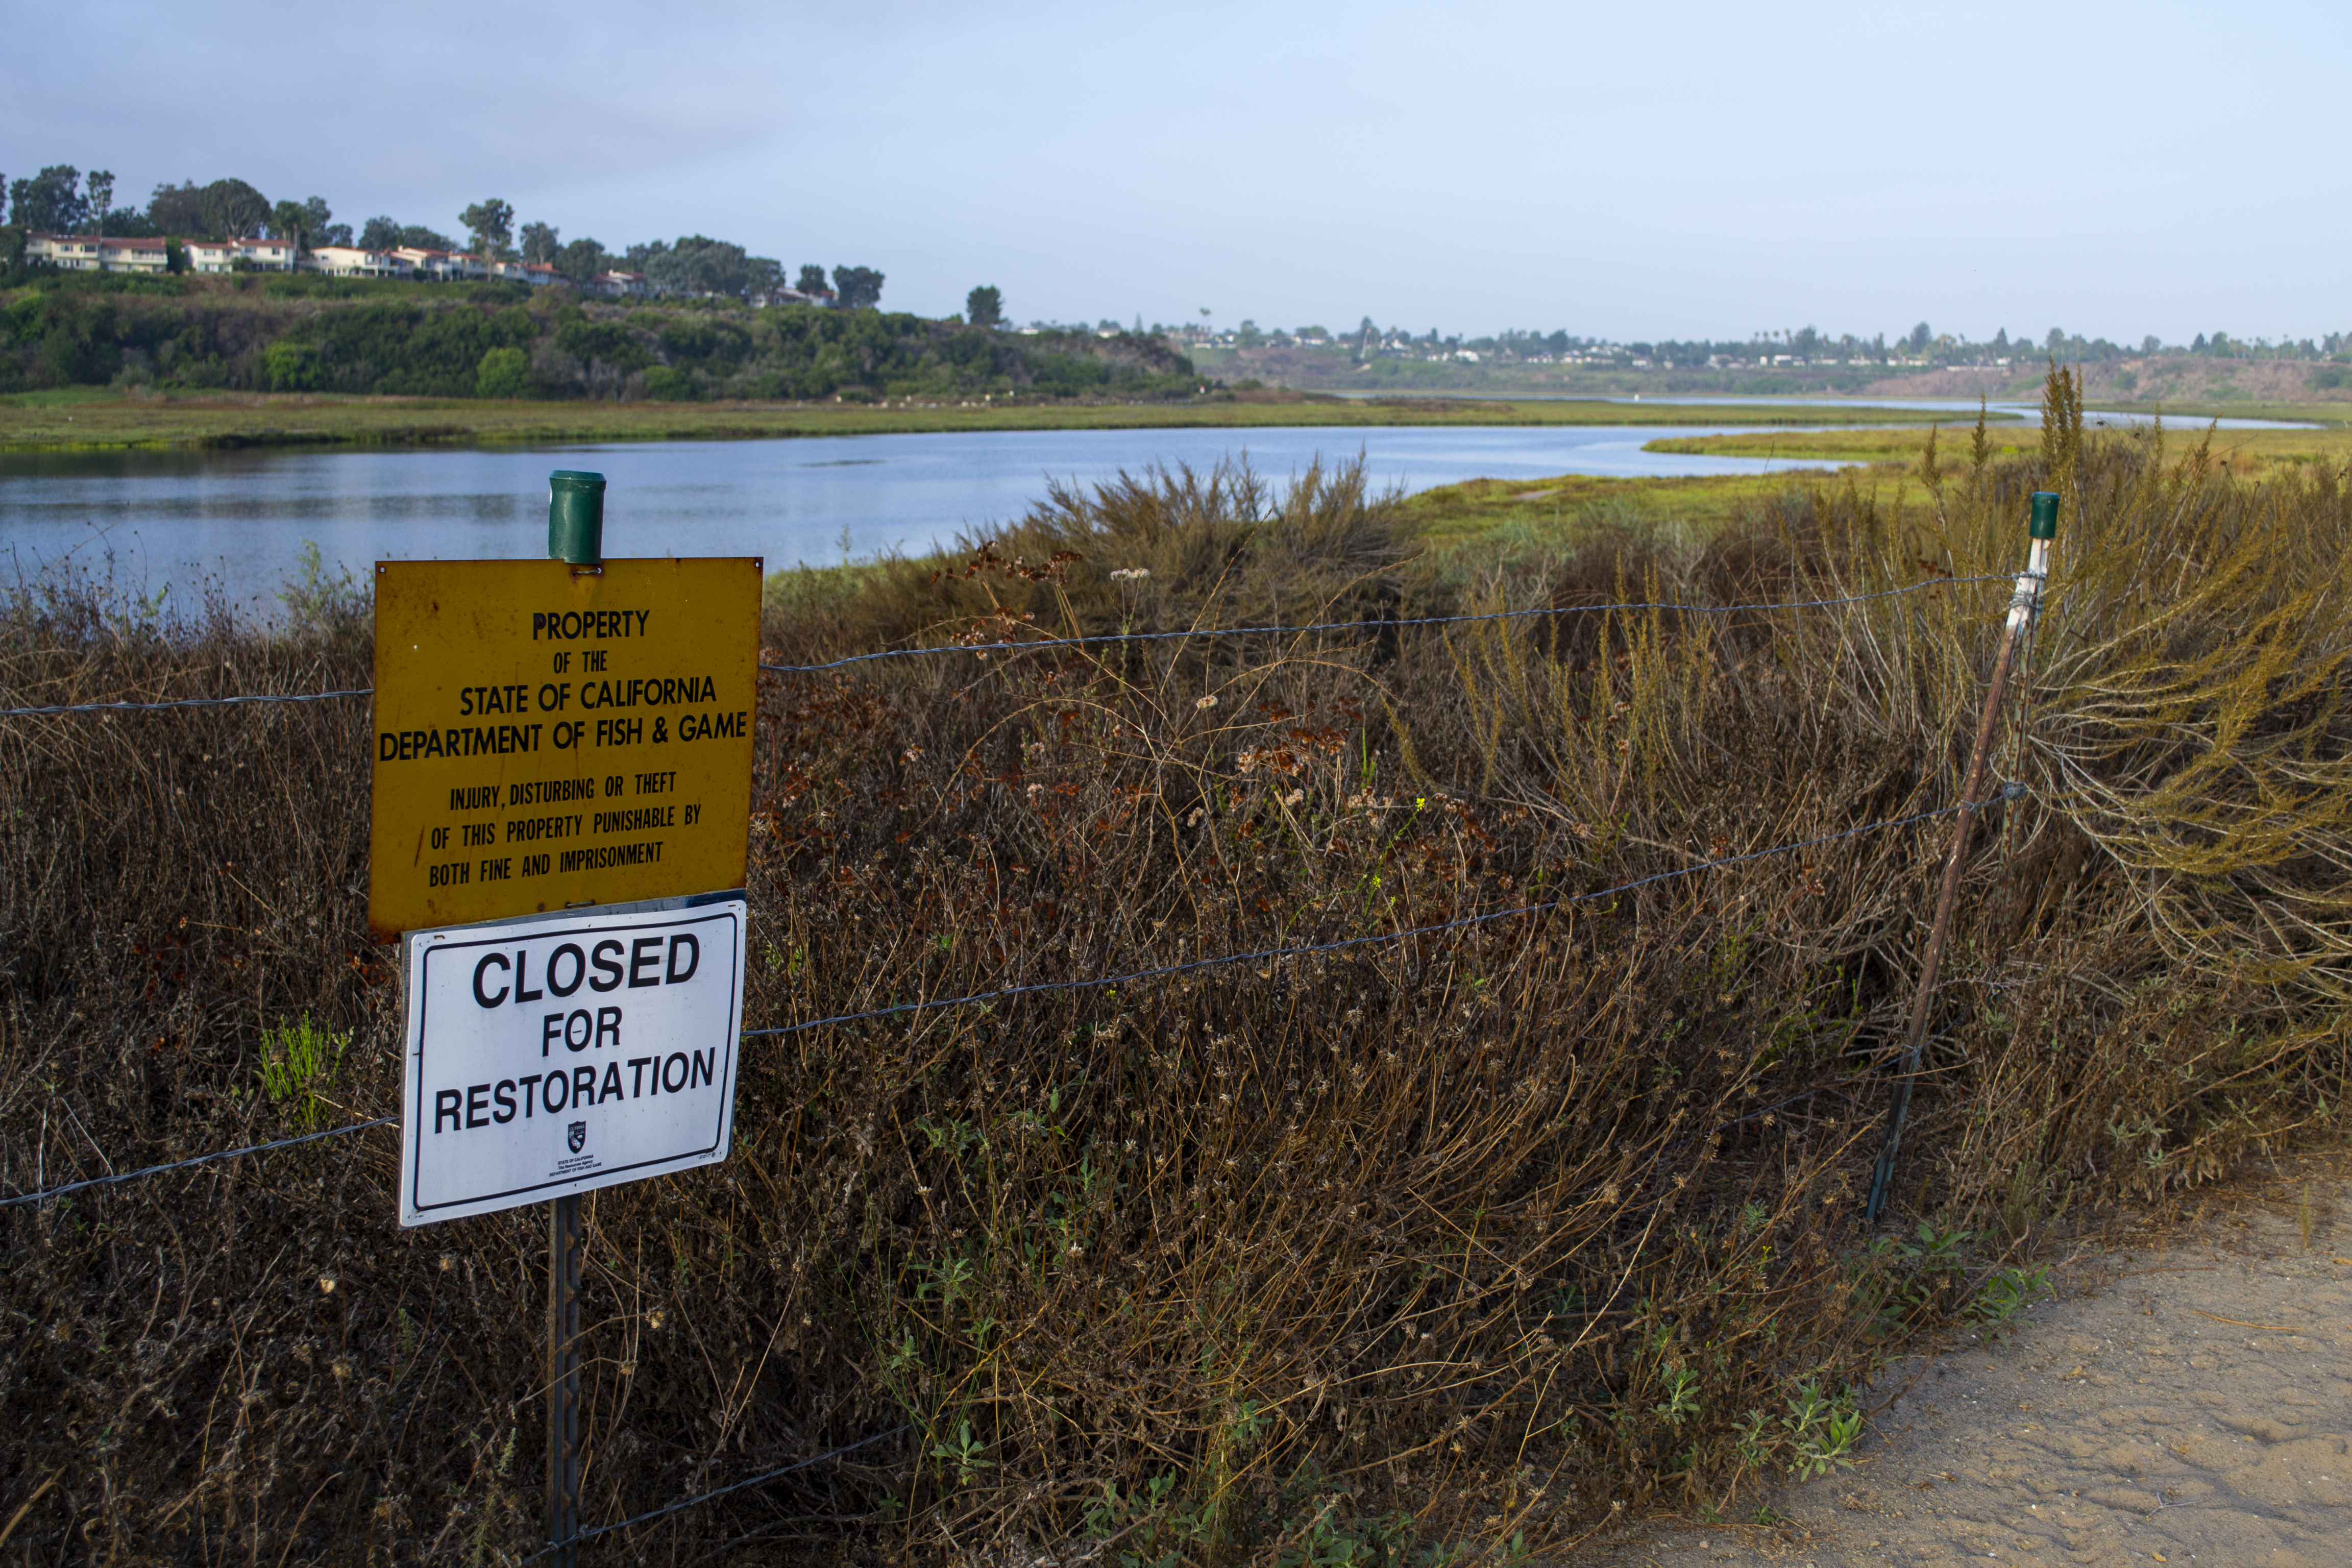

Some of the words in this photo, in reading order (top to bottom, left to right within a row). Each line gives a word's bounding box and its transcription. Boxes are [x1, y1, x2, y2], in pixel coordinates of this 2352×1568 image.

[532, 610, 650, 640] PROPERTY
[553, 652, 571, 673] OF
[583, 651, 608, 672] THE
[460, 685, 528, 715] STATE
[538, 683, 571, 710] OF
[581, 676, 716, 709] CALIFORNIA
[380, 724, 543, 761] DEPARTMENT
[552, 722, 585, 749] OF
[596, 718, 643, 746] FISH
[652, 716, 668, 743] &
[678, 712, 747, 741] GAME
[450, 786, 505, 811] INJURY,
[510, 778, 594, 805] DISTURBING
[605, 776, 623, 797] OR
[635, 772, 676, 794] THEFT
[431, 827, 450, 849] OF
[462, 823, 495, 846] THIS
[507, 815, 583, 842] PROPERTY
[594, 806, 675, 833] PUNISHABLE
[684, 804, 702, 824] BY
[429, 862, 470, 887] BOTH
[480, 858, 511, 881] FINE
[522, 854, 550, 877] AND
[560, 842, 664, 873] IMPRISONMENT
[472, 933, 700, 1009] CLOSED
[542, 1006, 622, 1057] FOR
[435, 1047, 716, 1134] RESTORATION
